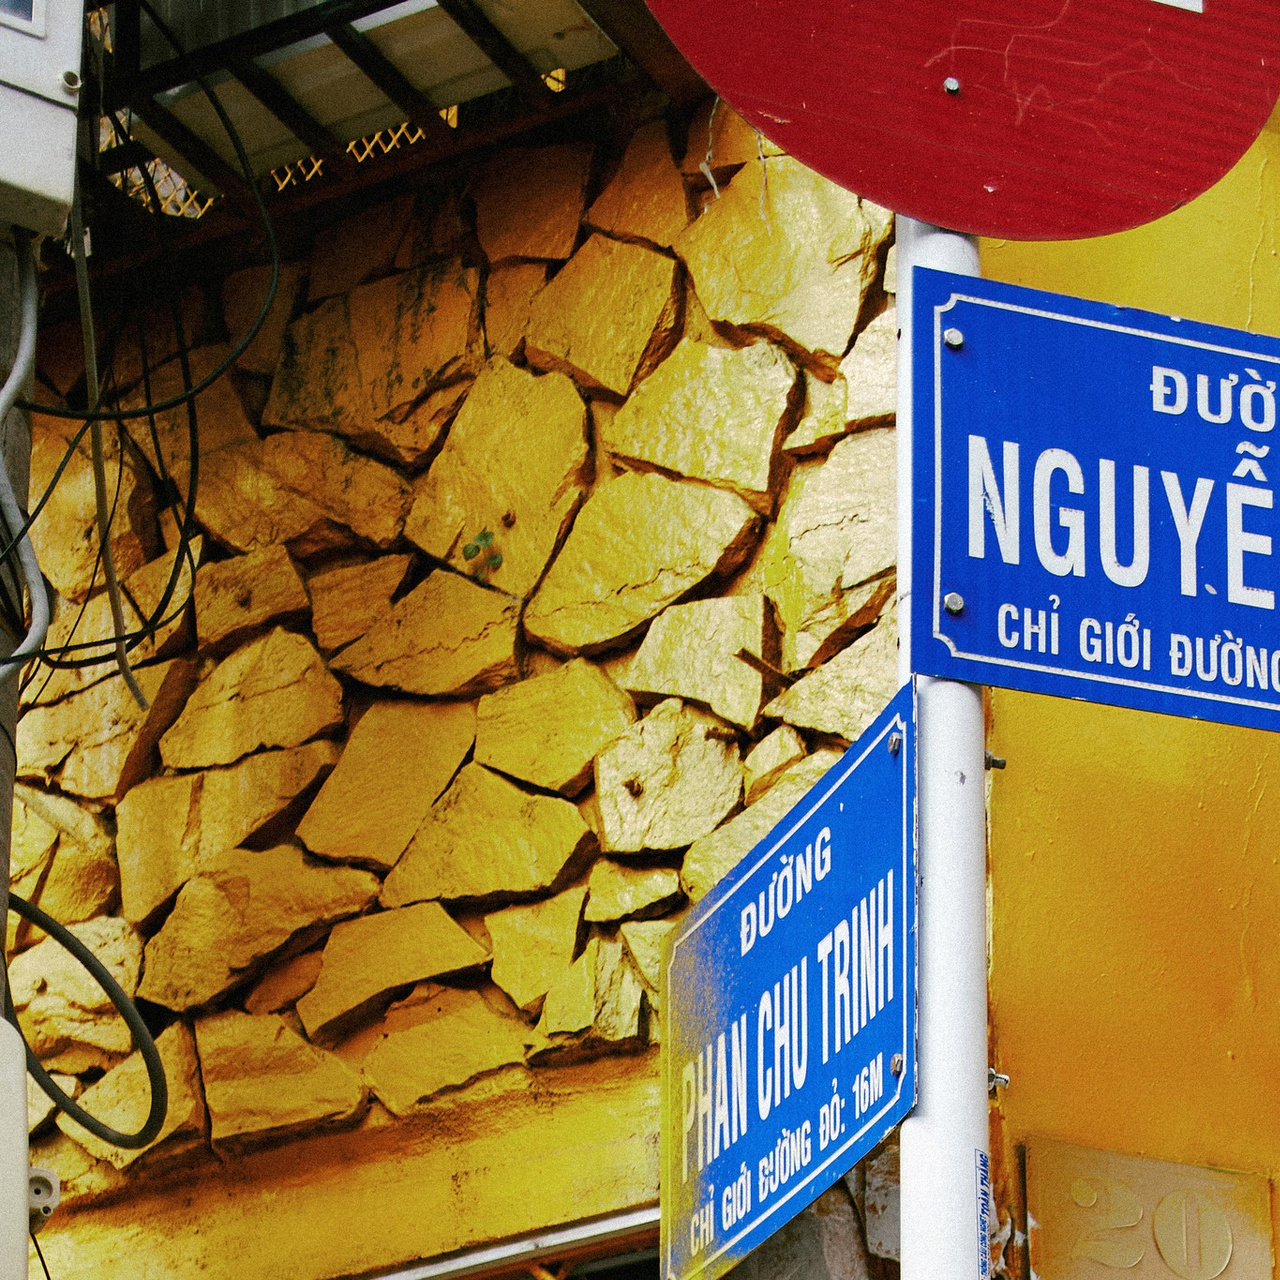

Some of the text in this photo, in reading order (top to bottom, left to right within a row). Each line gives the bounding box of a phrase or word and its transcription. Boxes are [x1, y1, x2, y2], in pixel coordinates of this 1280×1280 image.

[997, 595, 1060, 655] CHỈ
[1079, 613, 1151, 671] GIỚI
[740, 826, 832, 957] ĐƯỜNG
[682, 868, 894, 1184] PHAN CHU TRINH
[690, 1052, 884, 1257] CHỈ GIỚI ĐƯỜNG ĐỎ: 16M
